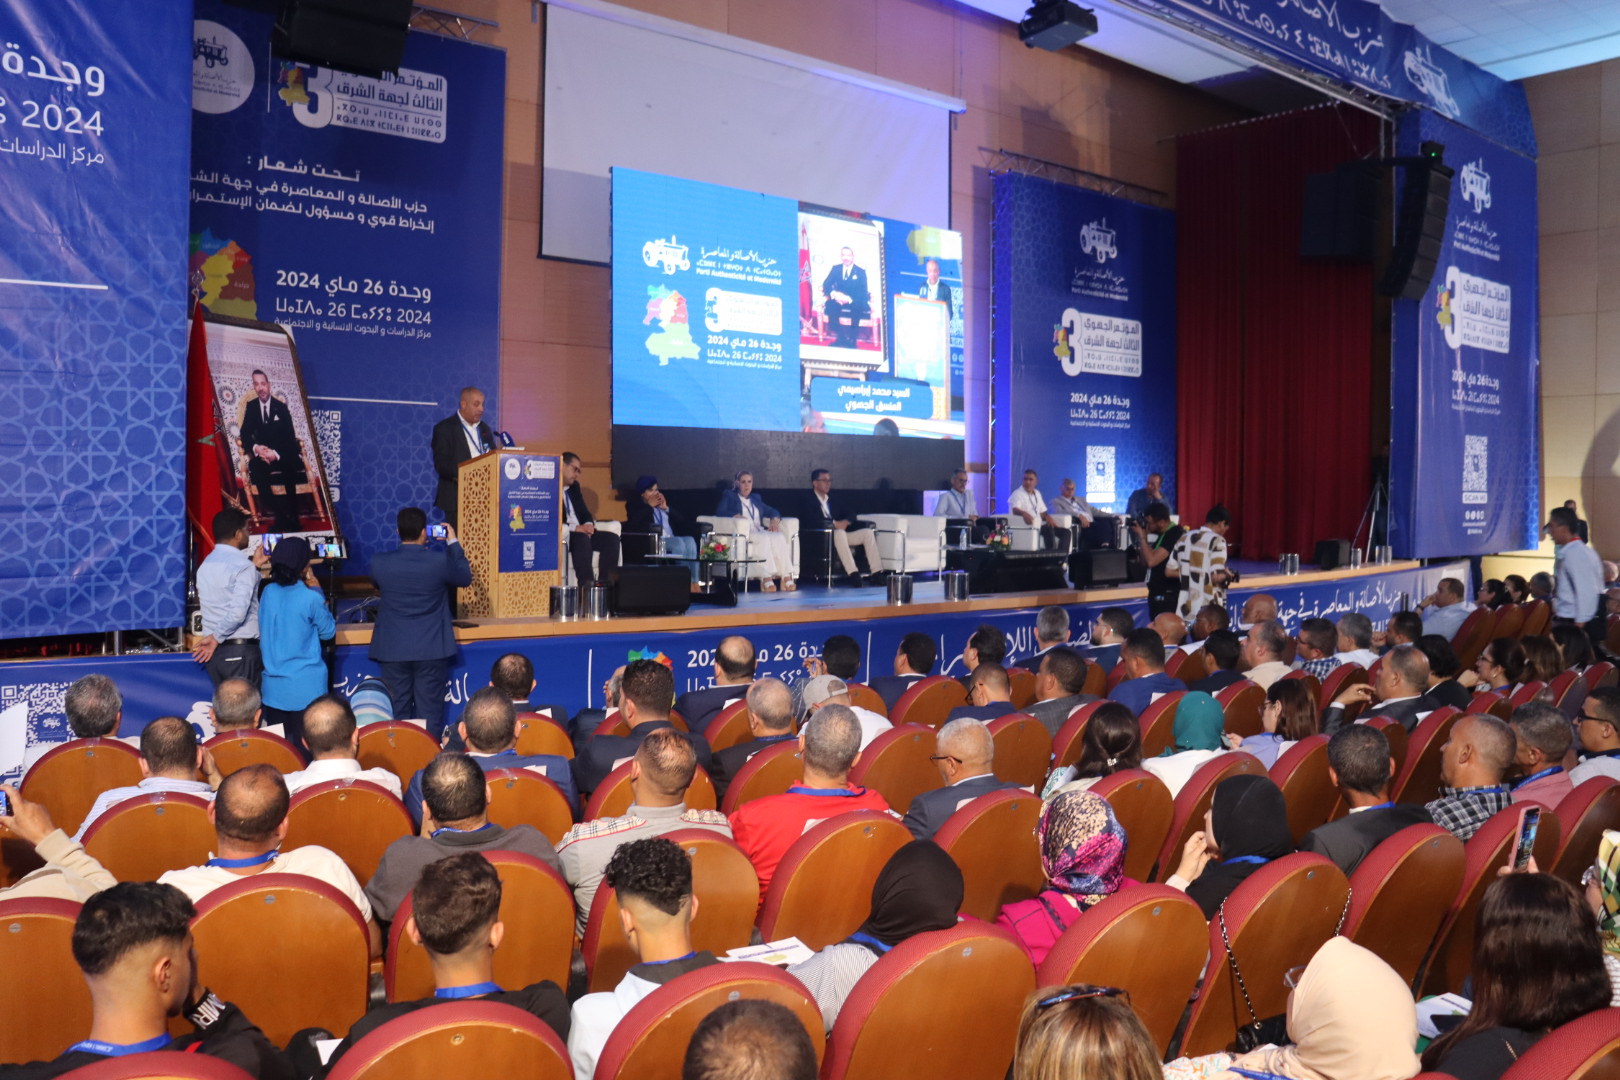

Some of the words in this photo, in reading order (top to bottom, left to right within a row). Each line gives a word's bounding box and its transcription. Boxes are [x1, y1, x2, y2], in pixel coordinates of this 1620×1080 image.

[2, 42, 105, 97] وجدة
[336, 81, 375, 98] الشرق
[378, 89, 409, 108] لجهة
[412, 92, 443, 112] الثالث
[22, 100, 104, 136] 2024
[0, 137, 66, 161] الدراسات
[71, 147, 104, 166] مركز
[258, 155, 308, 175] شعار
[222, 173, 252, 191] جهة
[256, 180, 279, 195] في
[281, 182, 345, 201] المعاصرة
[255, 198, 302, 214] لضمان
[348, 194, 355, 205] و
[358, 192, 402, 210] الأصالة
[404, 199, 428, 213] حزب
[305, 204, 355, 221] مسؤول
[357, 213, 365, 224] و
[367, 215, 396, 228] قوي
[399, 215, 435, 234] إنخراط
[276, 270, 320, 289] 2024
[325, 276, 358, 297] ماي
[363, 278, 384, 295] 26
[388, 280, 432, 304] وجدة
[328, 302, 347, 318] 26
[396, 308, 432, 325] 2024
[354, 324, 379, 335] البحوث
[386, 325, 415, 338] الدراسات
[1084, 318, 1113, 332] الجهوي
[1113, 322, 1139, 335] المؤتمر
[416, 328, 432, 339] مركز
[707, 335, 729, 346] 2024
[730, 337, 747, 350] ماي
[748, 339, 759, 348] 26
[761, 340, 782, 352] وجدة
[732, 350, 741, 359] 26
[765, 353, 782, 362] 2024
[1477, 374, 1486, 386] 26
[872, 386, 892, 397] محمد
[893, 387, 911, 398] السيد
[1070, 392, 1088, 403] 2024
[845, 400, 874, 412] الجهوي
[1089, 394, 1102, 407] ماي
[1103, 394, 1112, 405] 26
[1113, 395, 1130, 408] وجدة
[875, 401, 902, 413] المنسق
[1090, 409, 1098, 418] 26
[1116, 411, 1130, 420] 2024
[774, 644, 794, 661] 26
